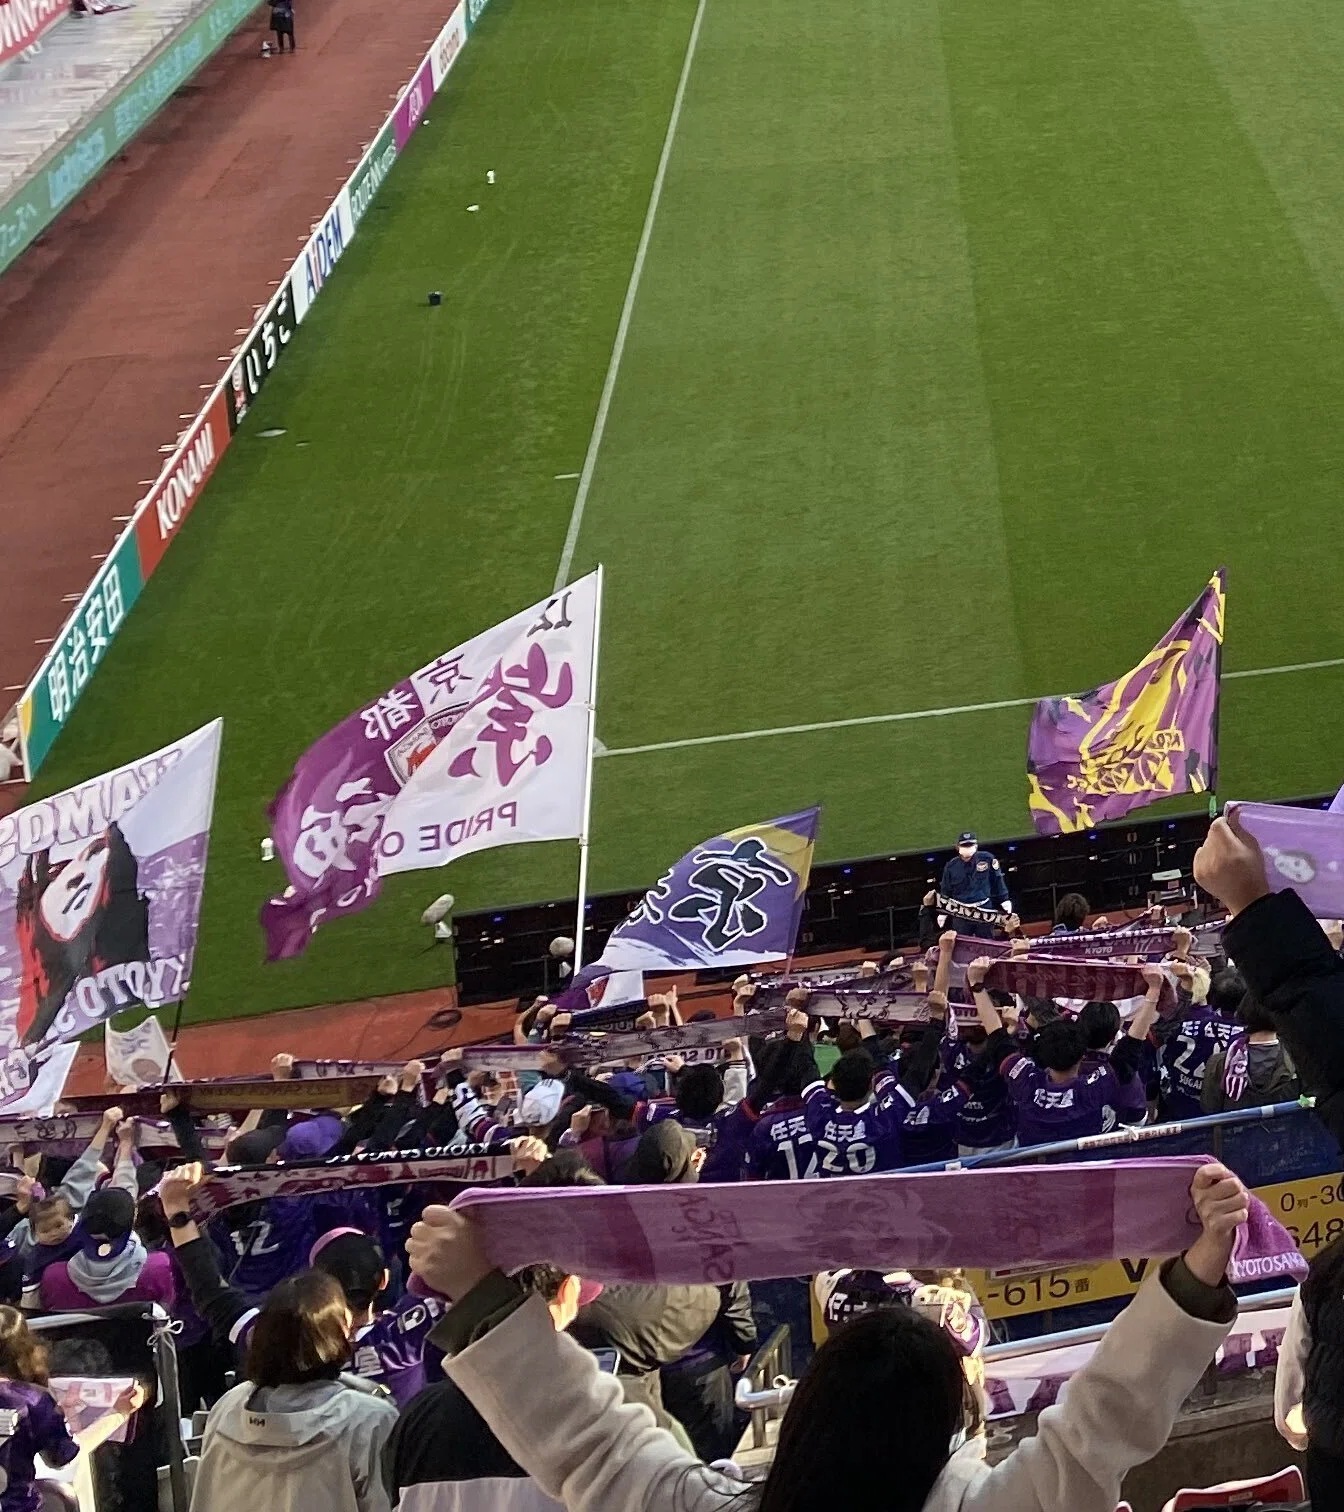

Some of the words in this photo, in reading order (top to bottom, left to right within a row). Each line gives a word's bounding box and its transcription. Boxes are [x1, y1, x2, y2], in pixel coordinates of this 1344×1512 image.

[155, 423, 216, 540] KONAMI
[48, 564, 125, 724] 明治安田
[770, 1115, 809, 1142] 任天
[816, 1140, 876, 1175] 20
